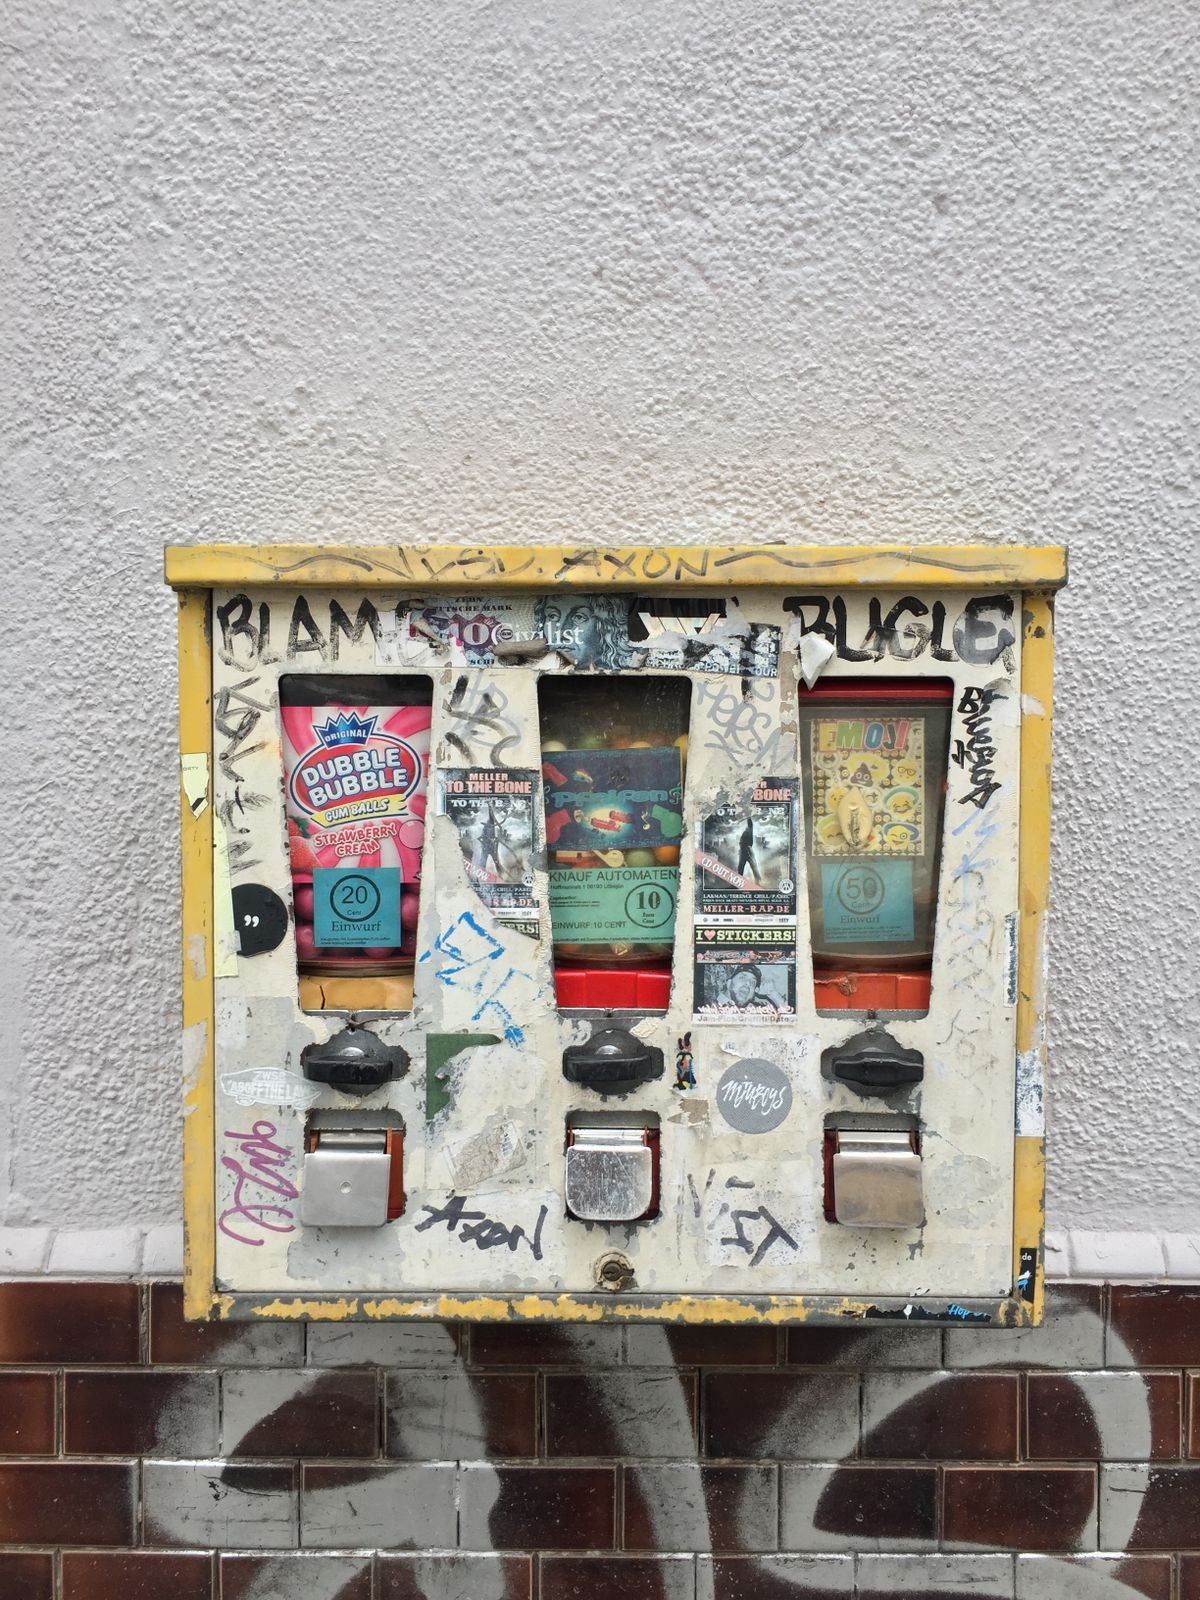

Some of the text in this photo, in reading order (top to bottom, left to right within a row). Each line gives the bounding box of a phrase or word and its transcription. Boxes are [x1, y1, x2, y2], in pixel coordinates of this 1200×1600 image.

[481, 604, 513, 612] MARK
[324, 731, 367, 742] ORIGINAL
[819, 720, 909, 752] EMOJI
[301, 747, 400, 787] DUBBLE
[469, 773, 508, 781] MELLER
[308, 769, 408, 807] BUBBLE
[446, 781, 532, 794] TO THE BONE
[752, 788, 791, 801] BONE
[314, 824, 397, 846] STRAWBERRY
[336, 840, 380, 857] CREAM
[549, 869, 677, 882] KNAUF AUTOMATEN
[712, 862, 730, 878] OUT
[341, 885, 368, 904] 20
[846, 877, 877, 899] 50
[636, 890, 661, 910] 10
[331, 920, 381, 932] Einwurf
[604, 921, 627, 929] CENT
[695, 930, 796, 941] I STICKERS!
